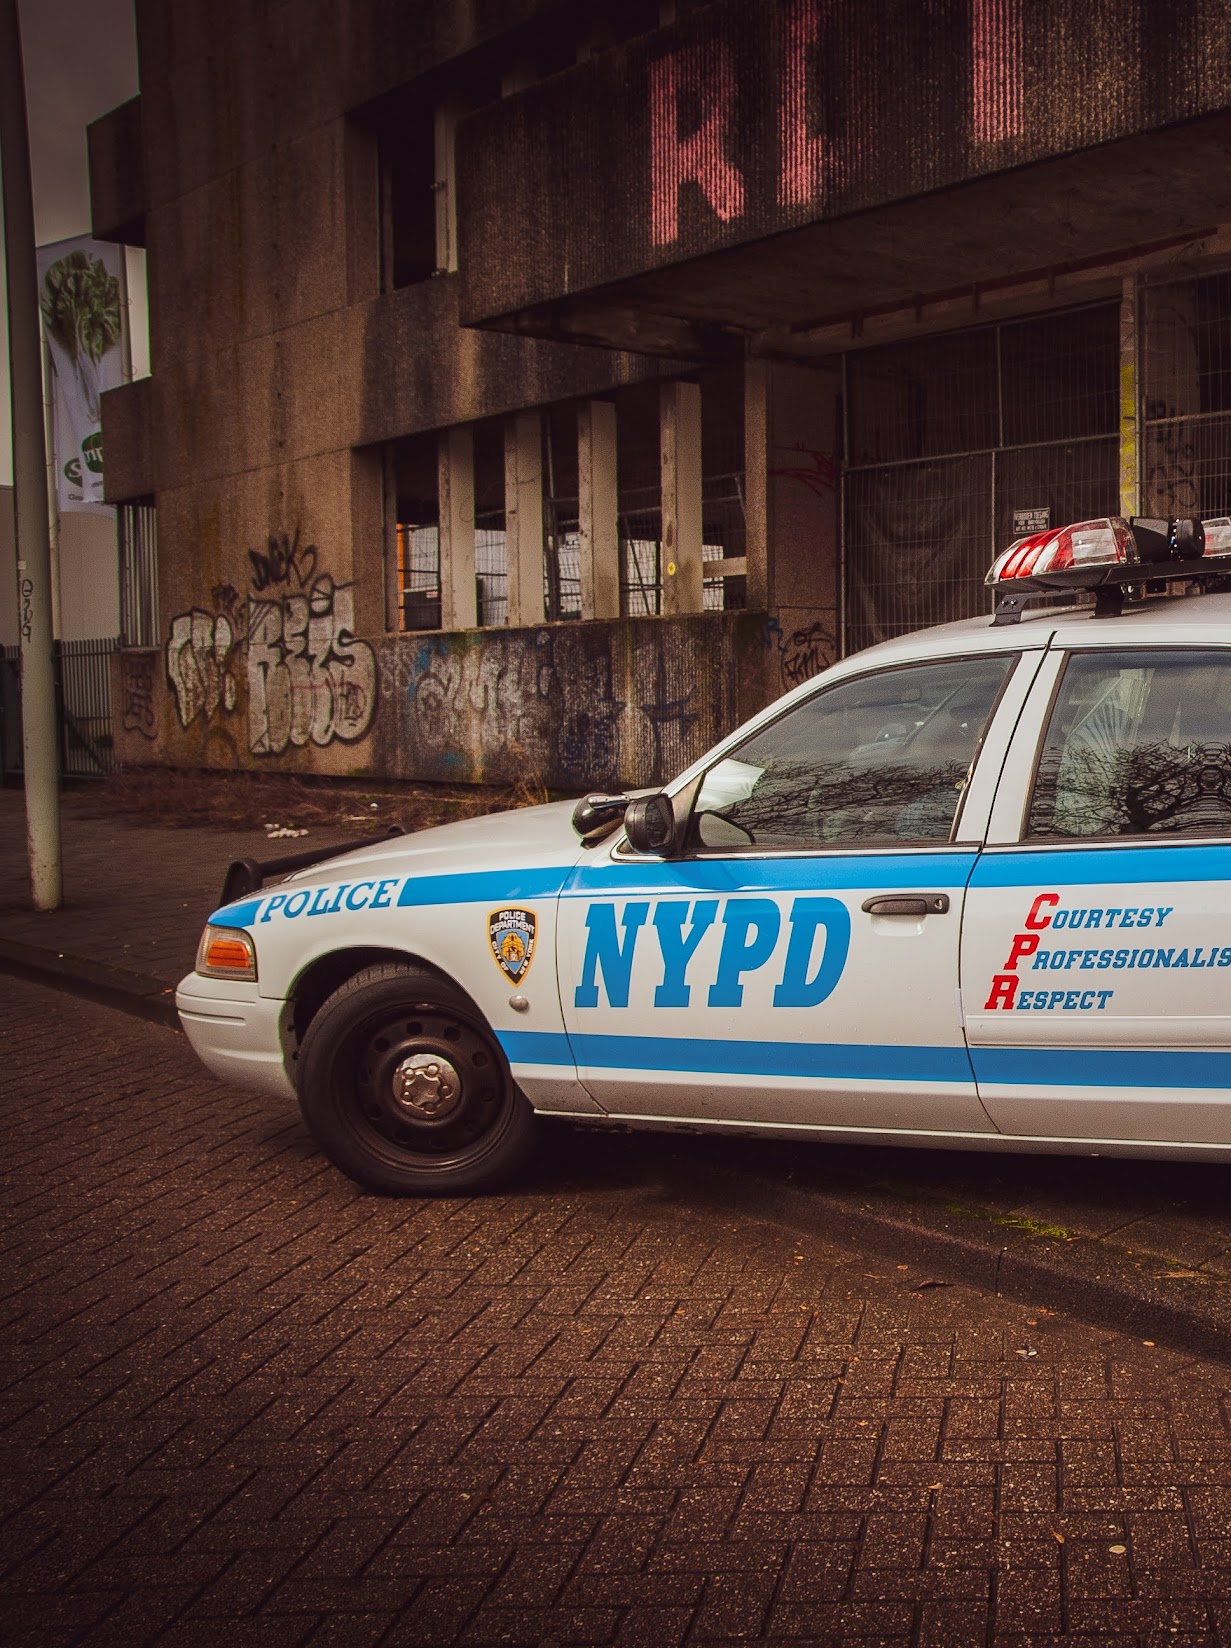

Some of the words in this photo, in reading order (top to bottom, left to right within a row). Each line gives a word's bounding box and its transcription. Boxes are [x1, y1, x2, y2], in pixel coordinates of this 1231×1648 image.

[261, 879, 400, 922] POLICE
[499, 911, 526, 921] POLICE
[1024, 892, 1174, 930] COURTESY
[490, 919, 535, 934] DEPARTMENT
[491, 940, 502, 960] CITY
[500, 961, 509, 972] OF
[574, 896, 852, 1008] NYPD
[984, 975, 1113, 1010] RESPECT
